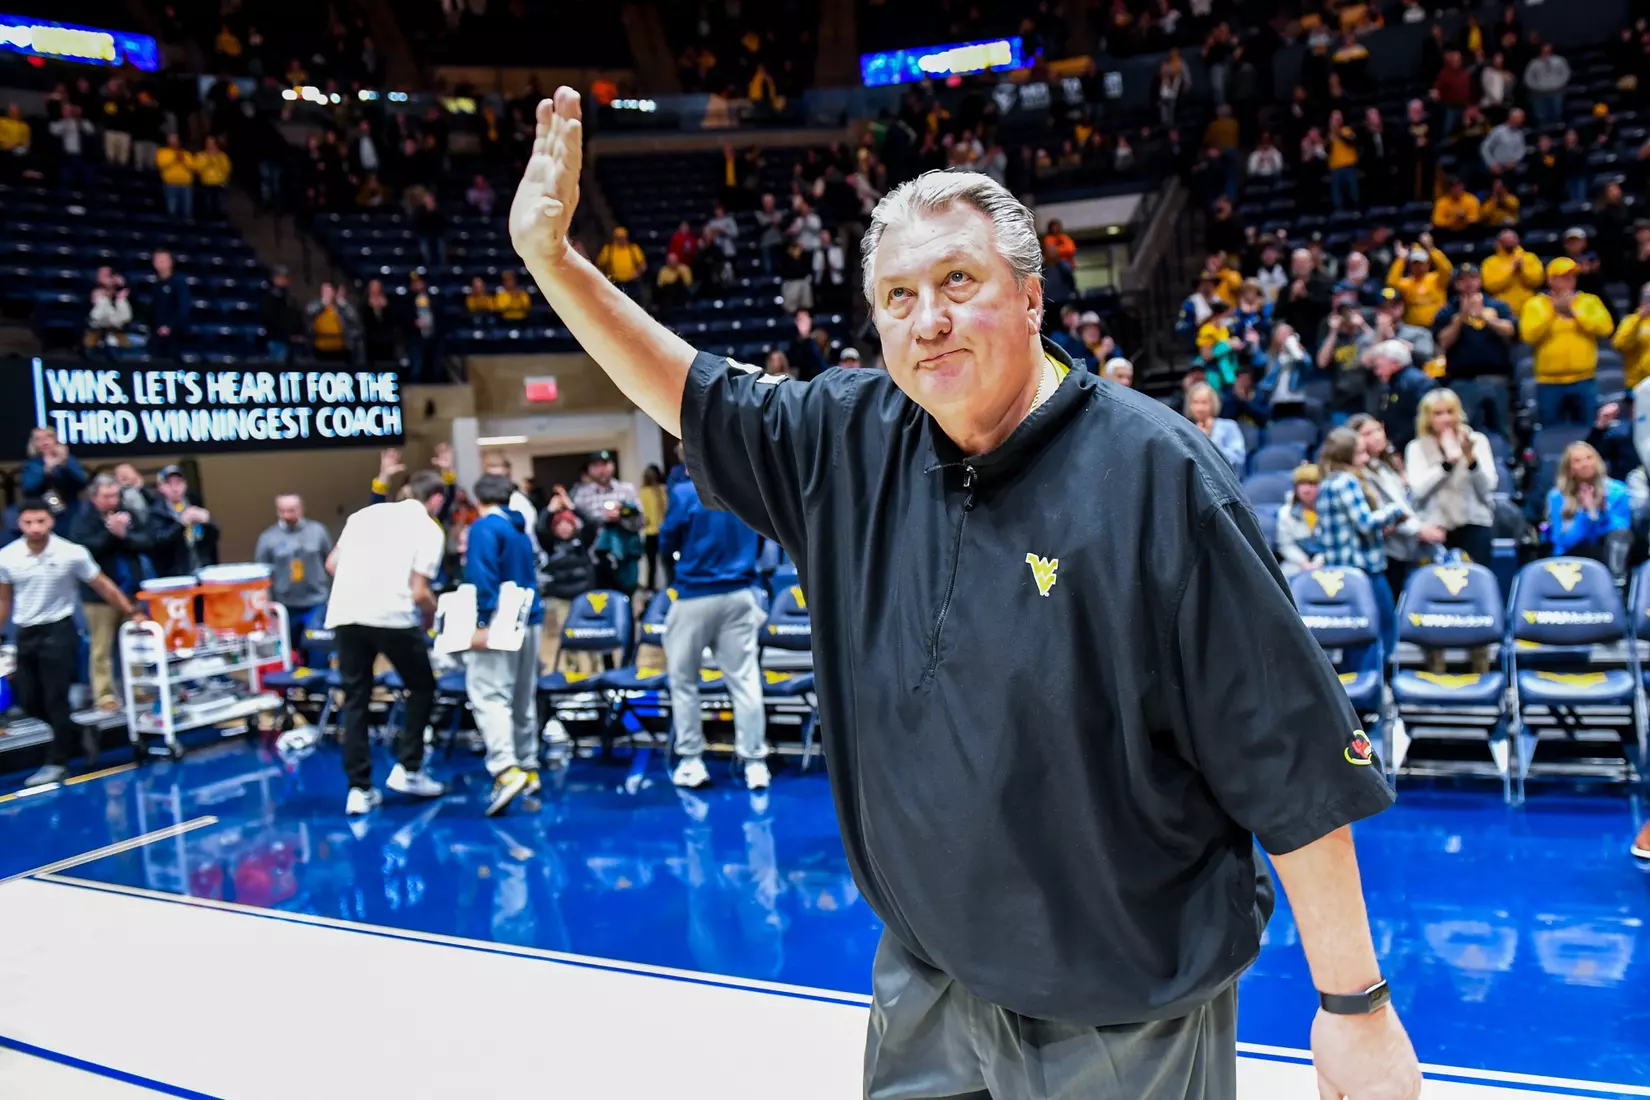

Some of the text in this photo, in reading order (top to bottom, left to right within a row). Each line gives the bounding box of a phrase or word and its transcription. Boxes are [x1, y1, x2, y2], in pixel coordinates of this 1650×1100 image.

[46, 369, 400, 404] WINS. LET'S HEAR IT FOR THE
[49, 406, 403, 444] THIRD WINNINGEST COACH
